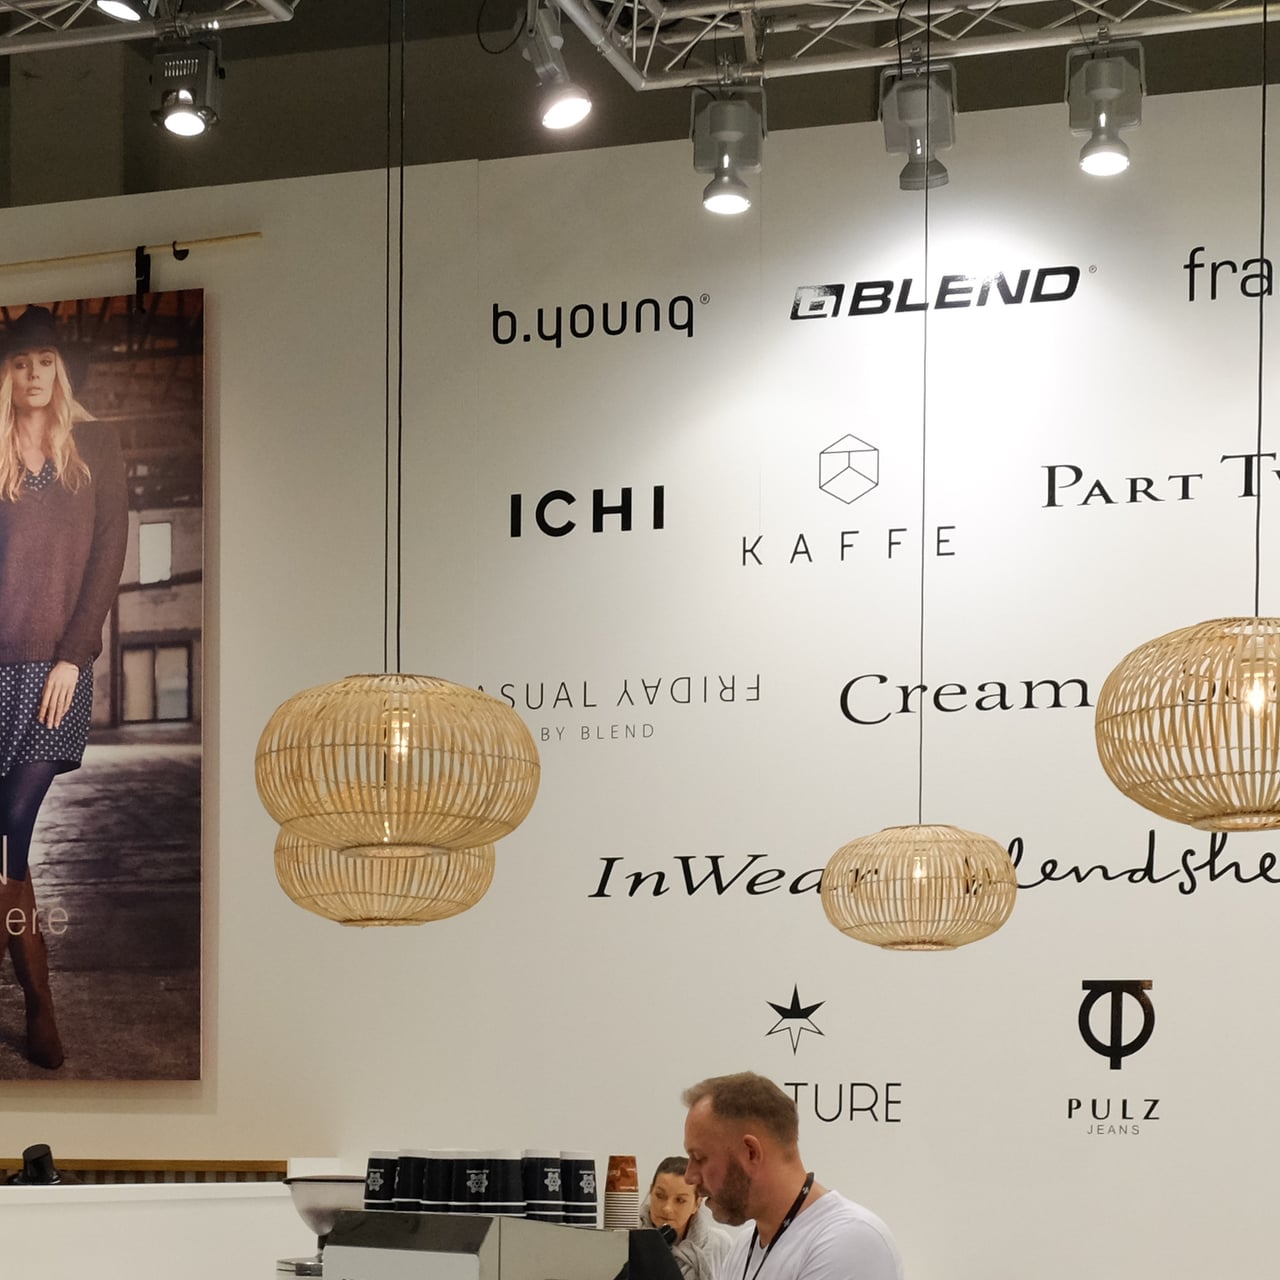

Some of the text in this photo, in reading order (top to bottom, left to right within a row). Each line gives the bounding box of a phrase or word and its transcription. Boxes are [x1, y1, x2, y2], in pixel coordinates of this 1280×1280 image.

[848, 265, 1081, 317] BLEND
[510, 485, 665, 538] ICHI
[742, 526, 957, 566] KAFFE
[476, 680, 598, 711] SUAL
[839, 673, 1095, 725] Cream
[540, 723, 655, 742] BY BLEND
[1067, 1097, 1161, 1121] PULZ
[1087, 1123, 1140, 1136] JEANS
